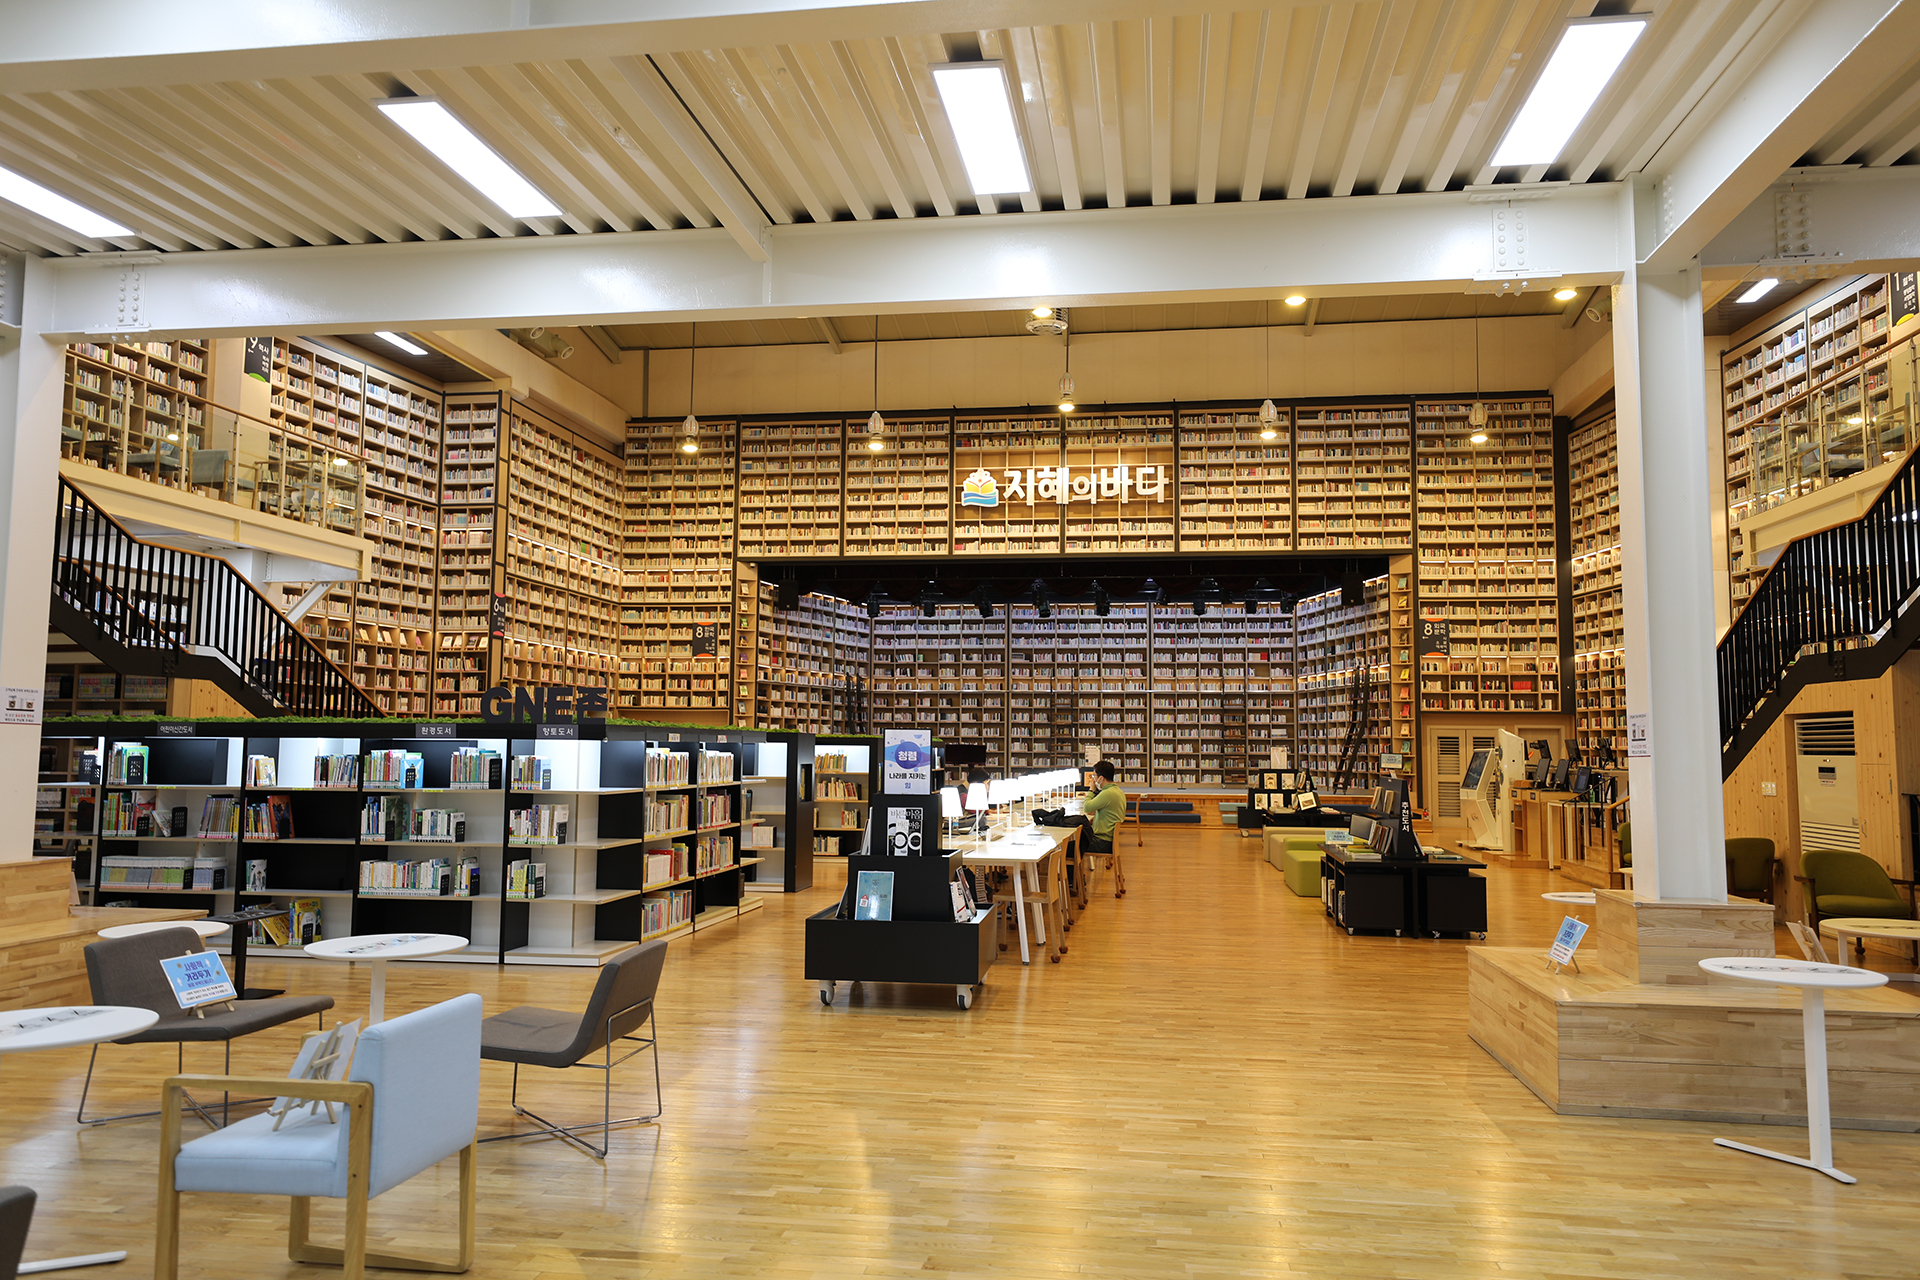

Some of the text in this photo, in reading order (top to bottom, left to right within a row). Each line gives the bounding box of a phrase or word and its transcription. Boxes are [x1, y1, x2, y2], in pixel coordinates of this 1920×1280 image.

[1894, 272, 1900, 292] 1
[1003, 466, 1170, 506] 지혜의바다
[494, 598, 499, 612] 6
[696, 626, 703, 639] 8
[1424, 623, 1433, 636] 8
[480, 686, 609, 725] GNE존
[160, 725, 193, 734] 어린이신간도서
[421, 726, 452, 735] 환경도서
[542, 727, 574, 736] 향토도서
[898, 751, 917, 761] 청렴
[888, 772, 927, 780] 나라를 지키는
[1401, 801, 1409, 832] 추천도서
[183, 960, 205, 971] 사회적
[184, 969, 212, 982] 거리두기
